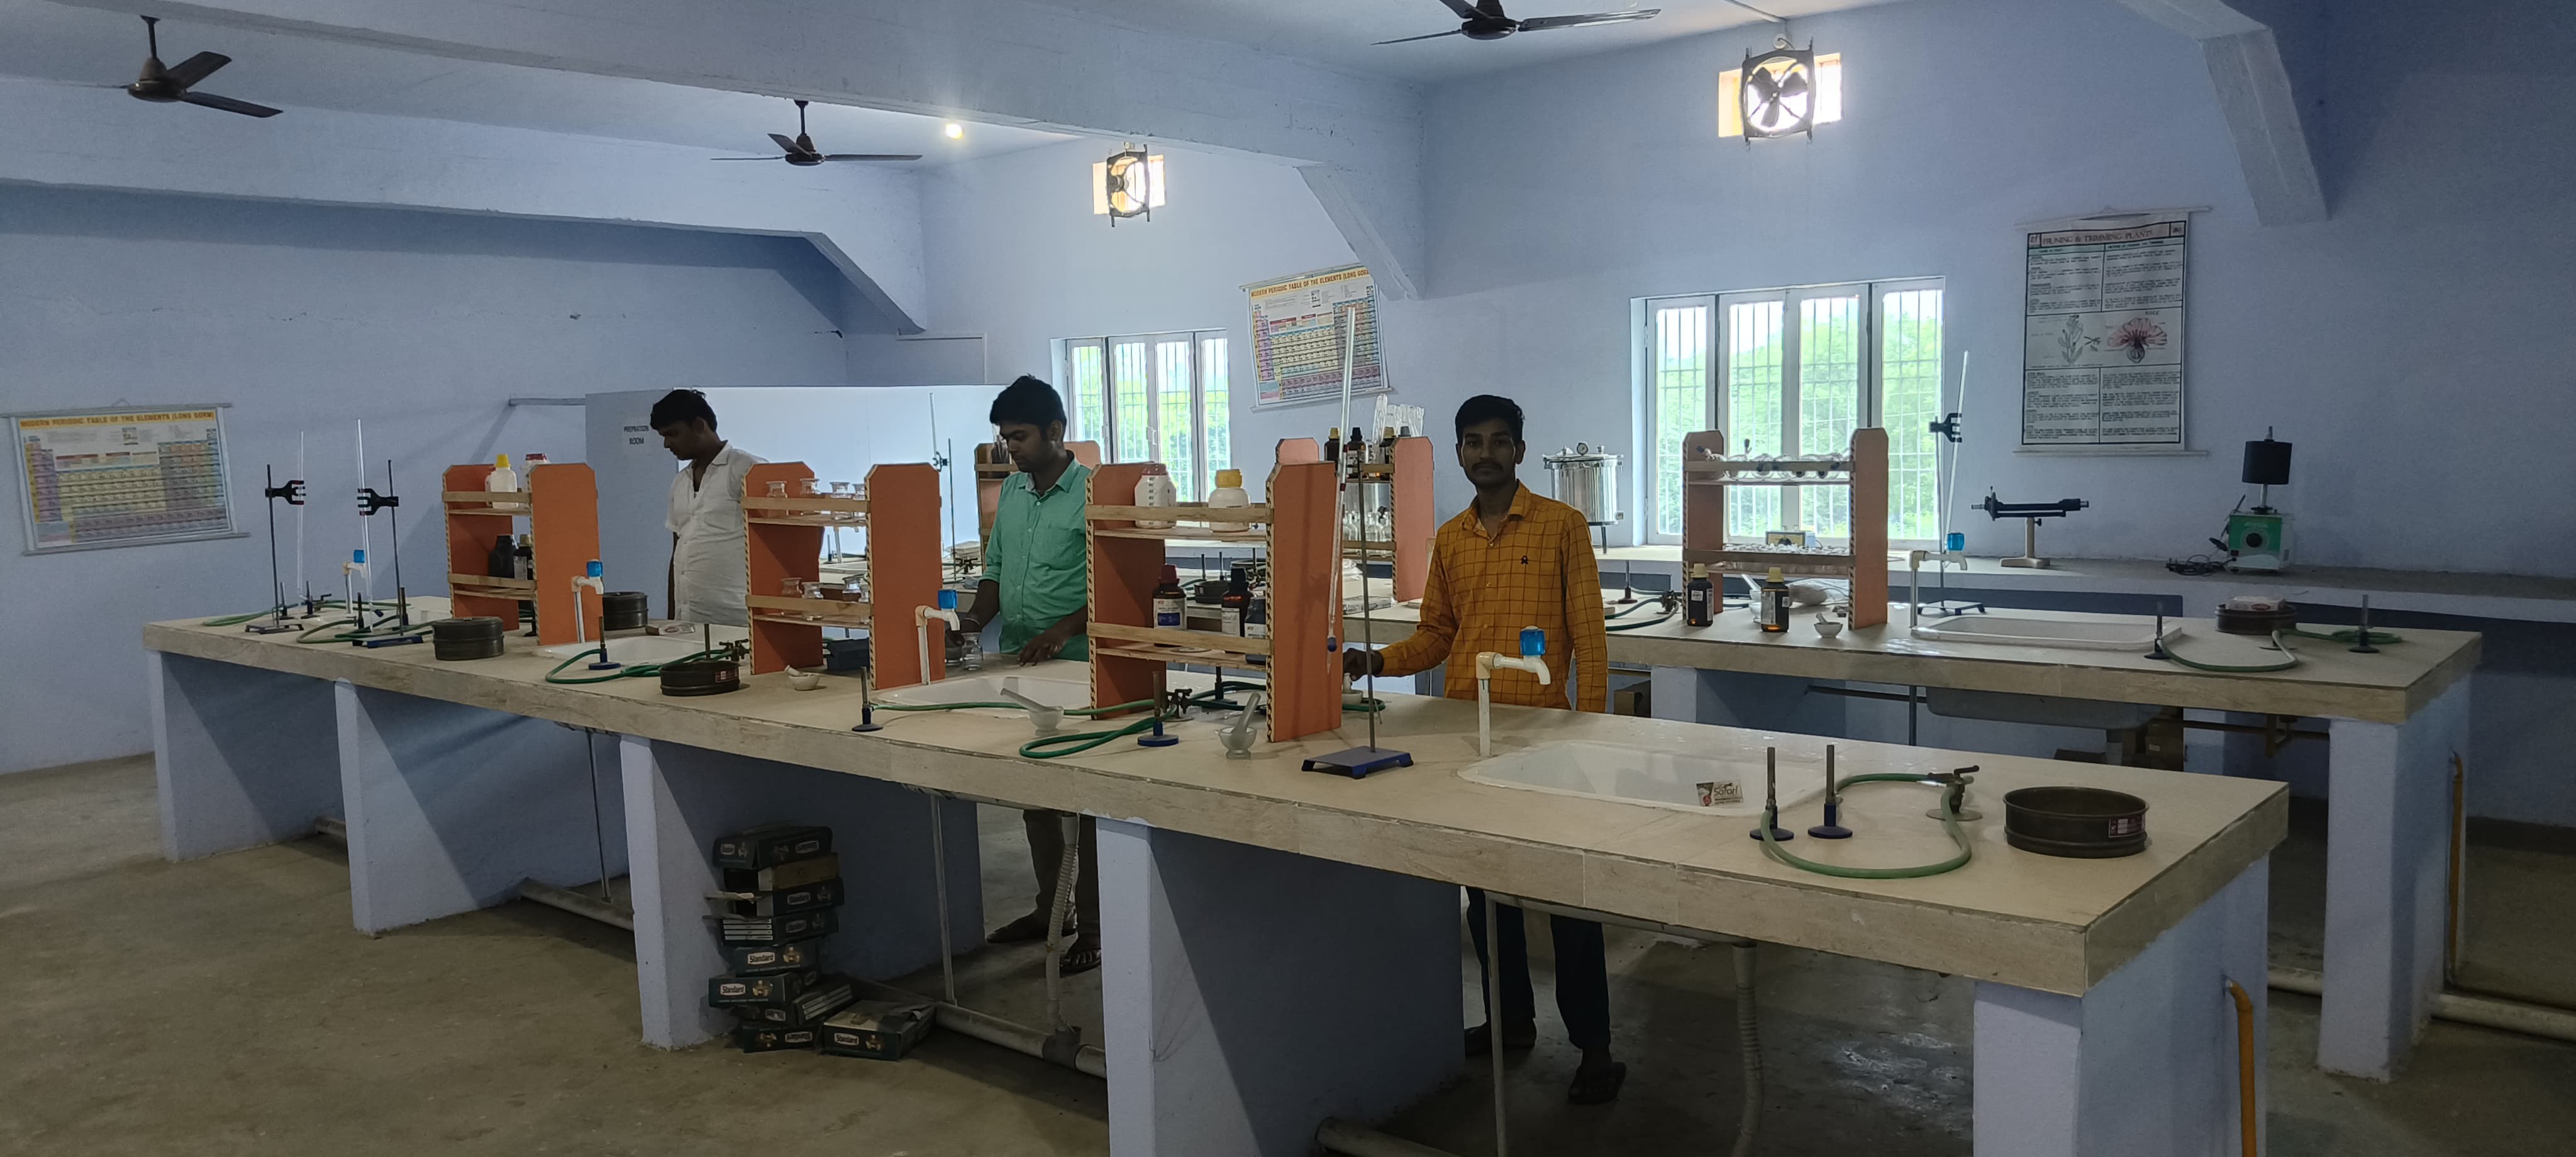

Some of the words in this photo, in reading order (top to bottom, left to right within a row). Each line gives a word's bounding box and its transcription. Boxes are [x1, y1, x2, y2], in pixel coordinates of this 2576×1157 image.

[2126, 230, 2153, 239] PLANTS
[1268, 284, 1287, 294] PERIODIC
[1319, 274, 1341, 284] ELEMENTS
[750, 954, 774, 963] Standard
[723, 985, 745, 994] Standard
[836, 1034, 858, 1044] Standard
